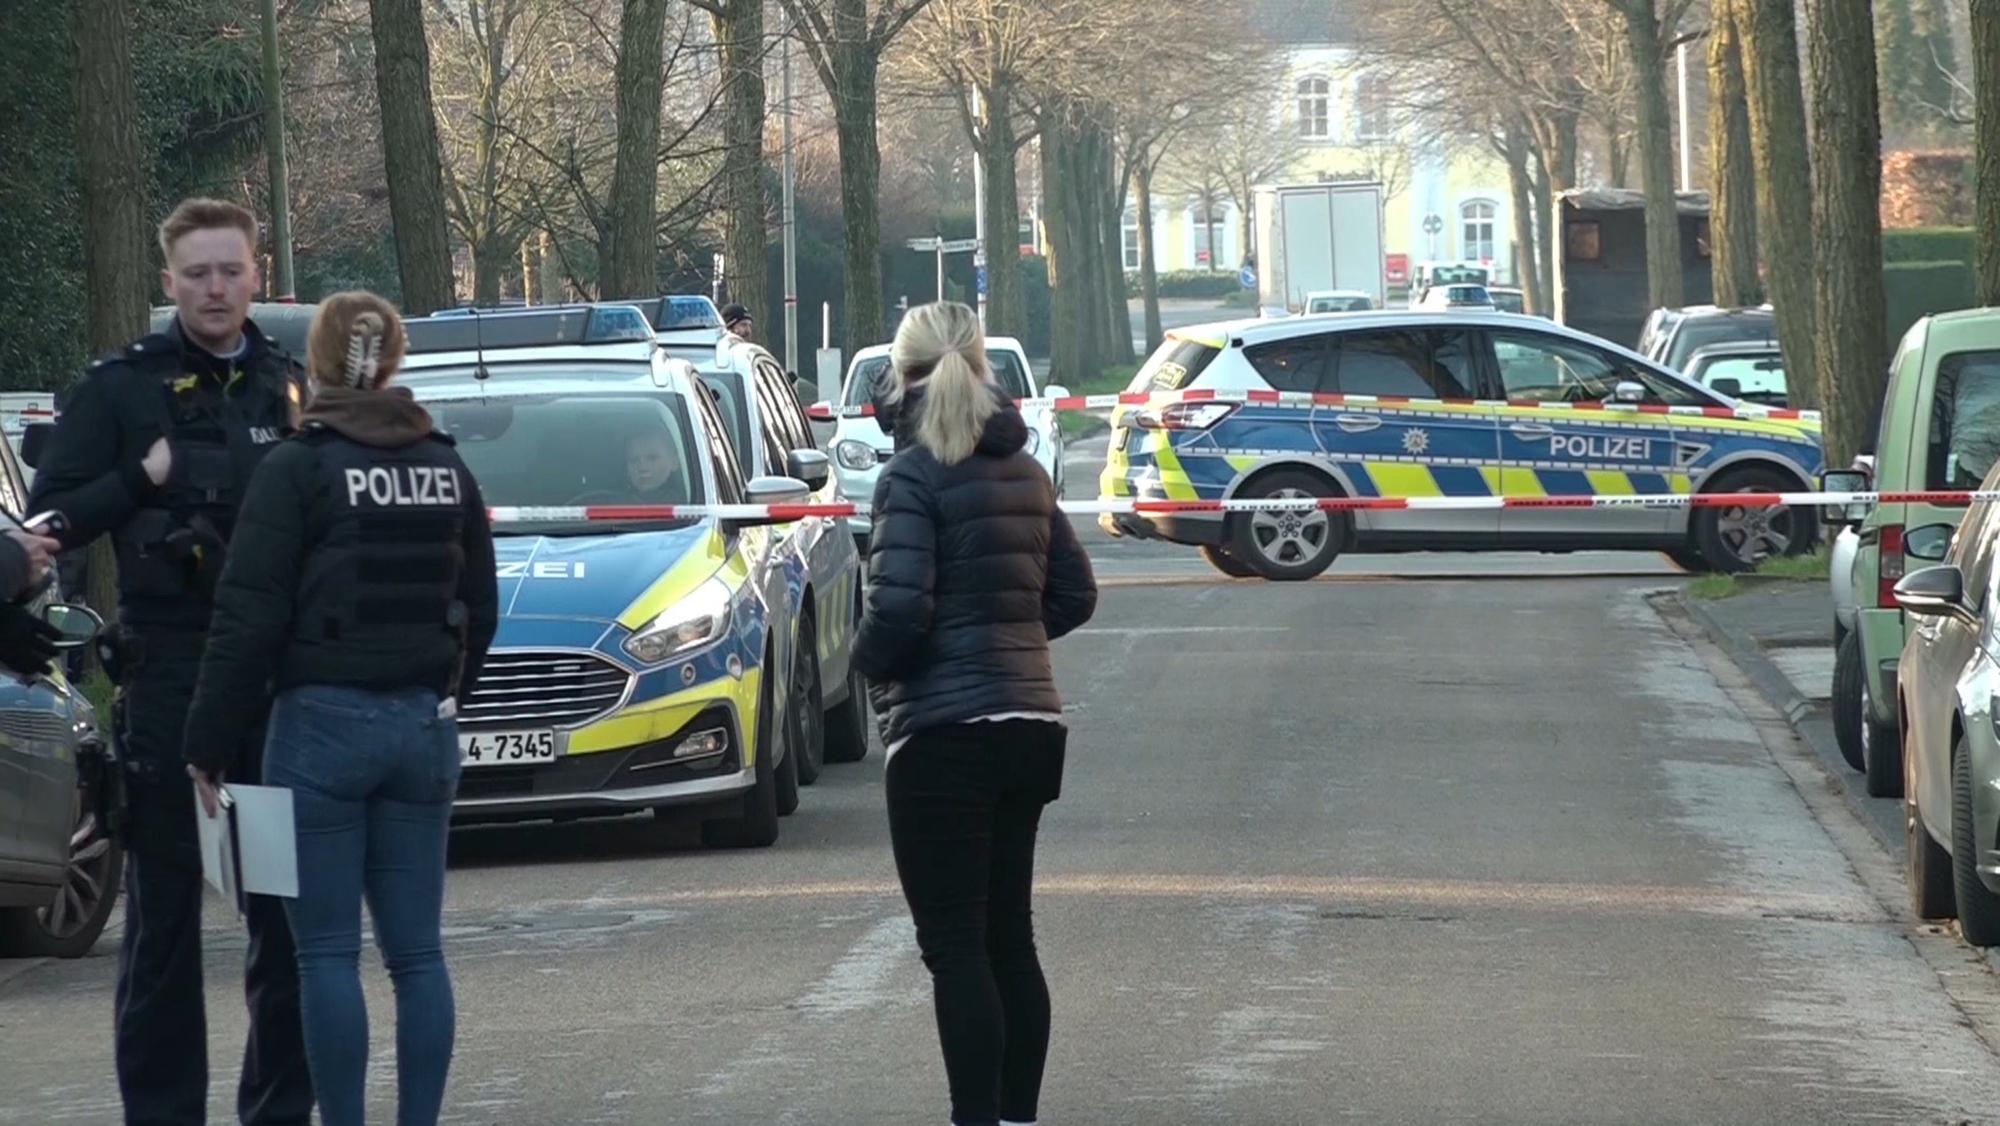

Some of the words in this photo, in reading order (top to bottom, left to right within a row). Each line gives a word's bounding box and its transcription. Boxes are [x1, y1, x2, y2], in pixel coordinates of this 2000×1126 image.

[1550, 436, 1650, 459] POLIZEI
[345, 466, 461, 506] POLIZEI
[468, 733, 553, 760] 4-7345
